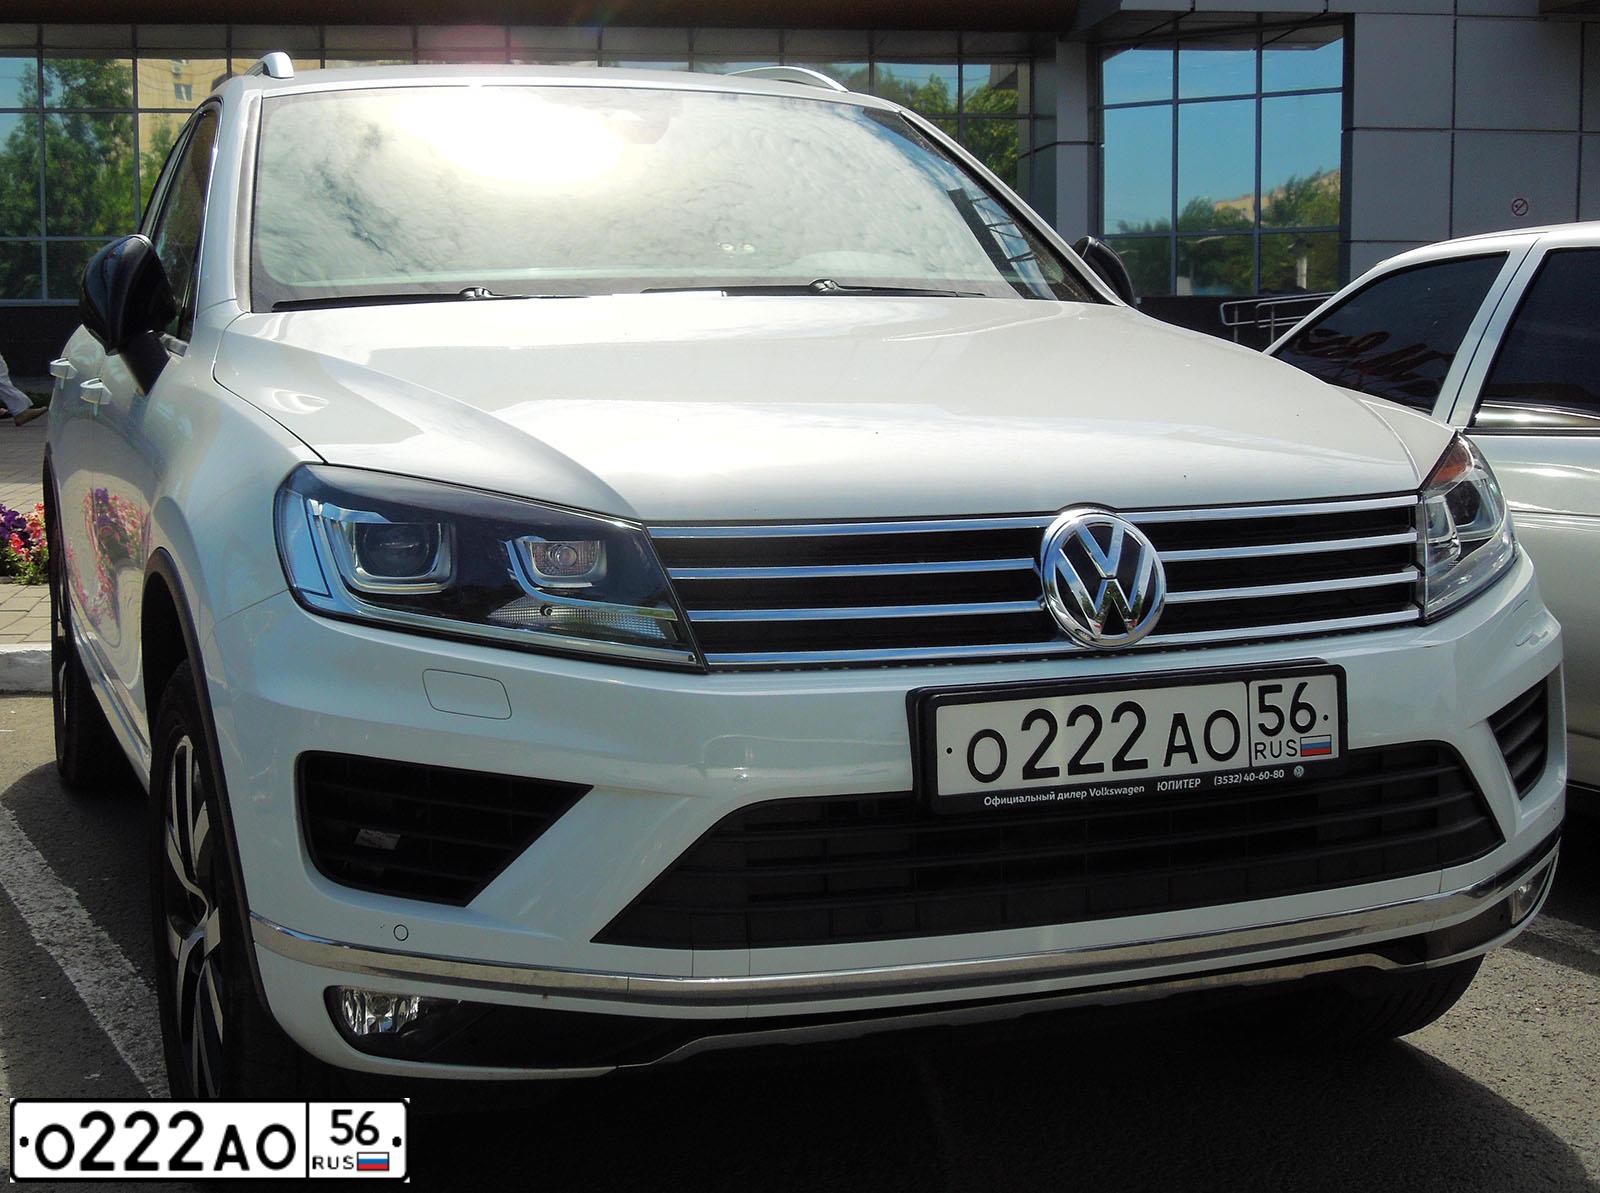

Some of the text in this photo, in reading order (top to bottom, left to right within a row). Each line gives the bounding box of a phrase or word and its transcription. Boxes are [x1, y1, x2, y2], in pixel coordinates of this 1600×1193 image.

[1258, 681, 1317, 737] 56
[1254, 739, 1298, 760] RUS
[983, 769, 1285, 807] Официальный дилер Volkswagen ЮПИТЕР (3532) 40-60-80
